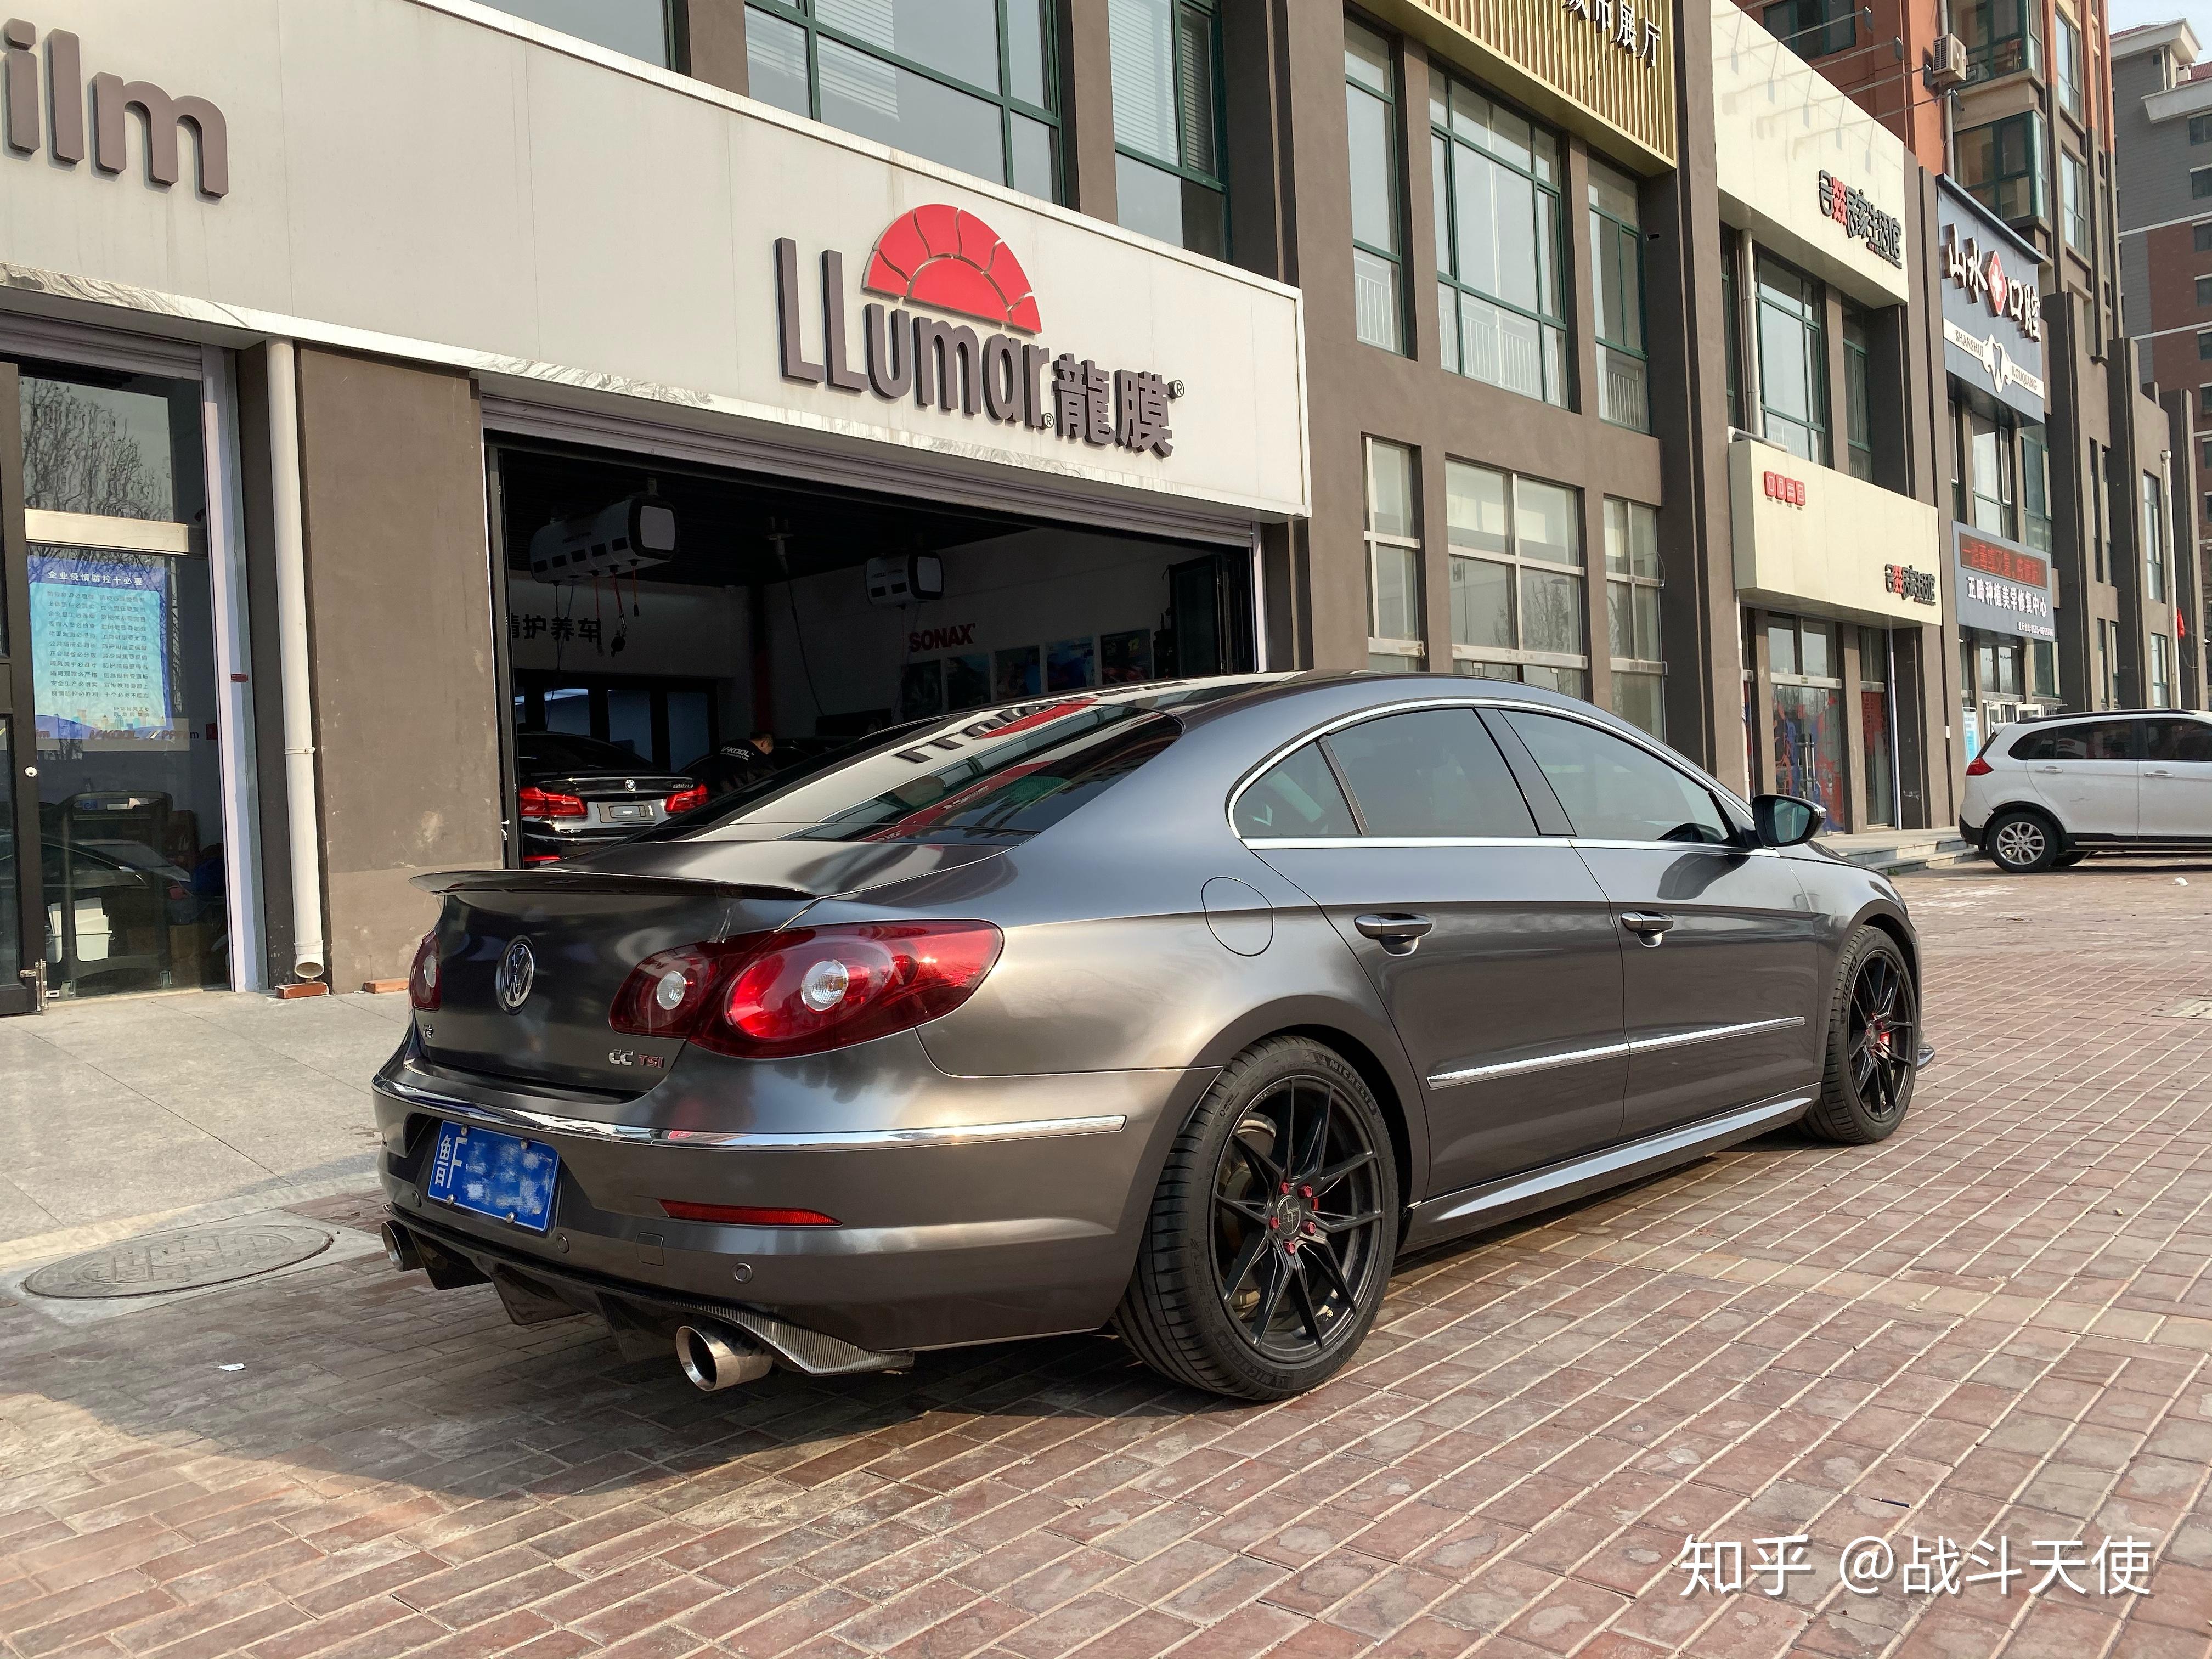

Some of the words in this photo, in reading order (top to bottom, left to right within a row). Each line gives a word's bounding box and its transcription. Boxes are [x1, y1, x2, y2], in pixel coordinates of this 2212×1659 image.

[775, 237, 1050, 430] LLumar
[1052, 353, 1173, 458] 龍膜
[1955, 329, 1984, 357] SHANSHUI
[2011, 364, 2038, 391] KOUQIANG
[48, 570, 144, 586] 企业疫情防控十必要
[1967, 576, 2047, 618] 正畸种植美学修复中心
[909, 623, 974, 653] SONAX
[721, 746, 750, 758] V-KOOL
[608, 1048, 634, 1066] CC
[638, 1054, 665, 1069] TSI
[1330, 1060, 1375, 1111] MICHELIN
